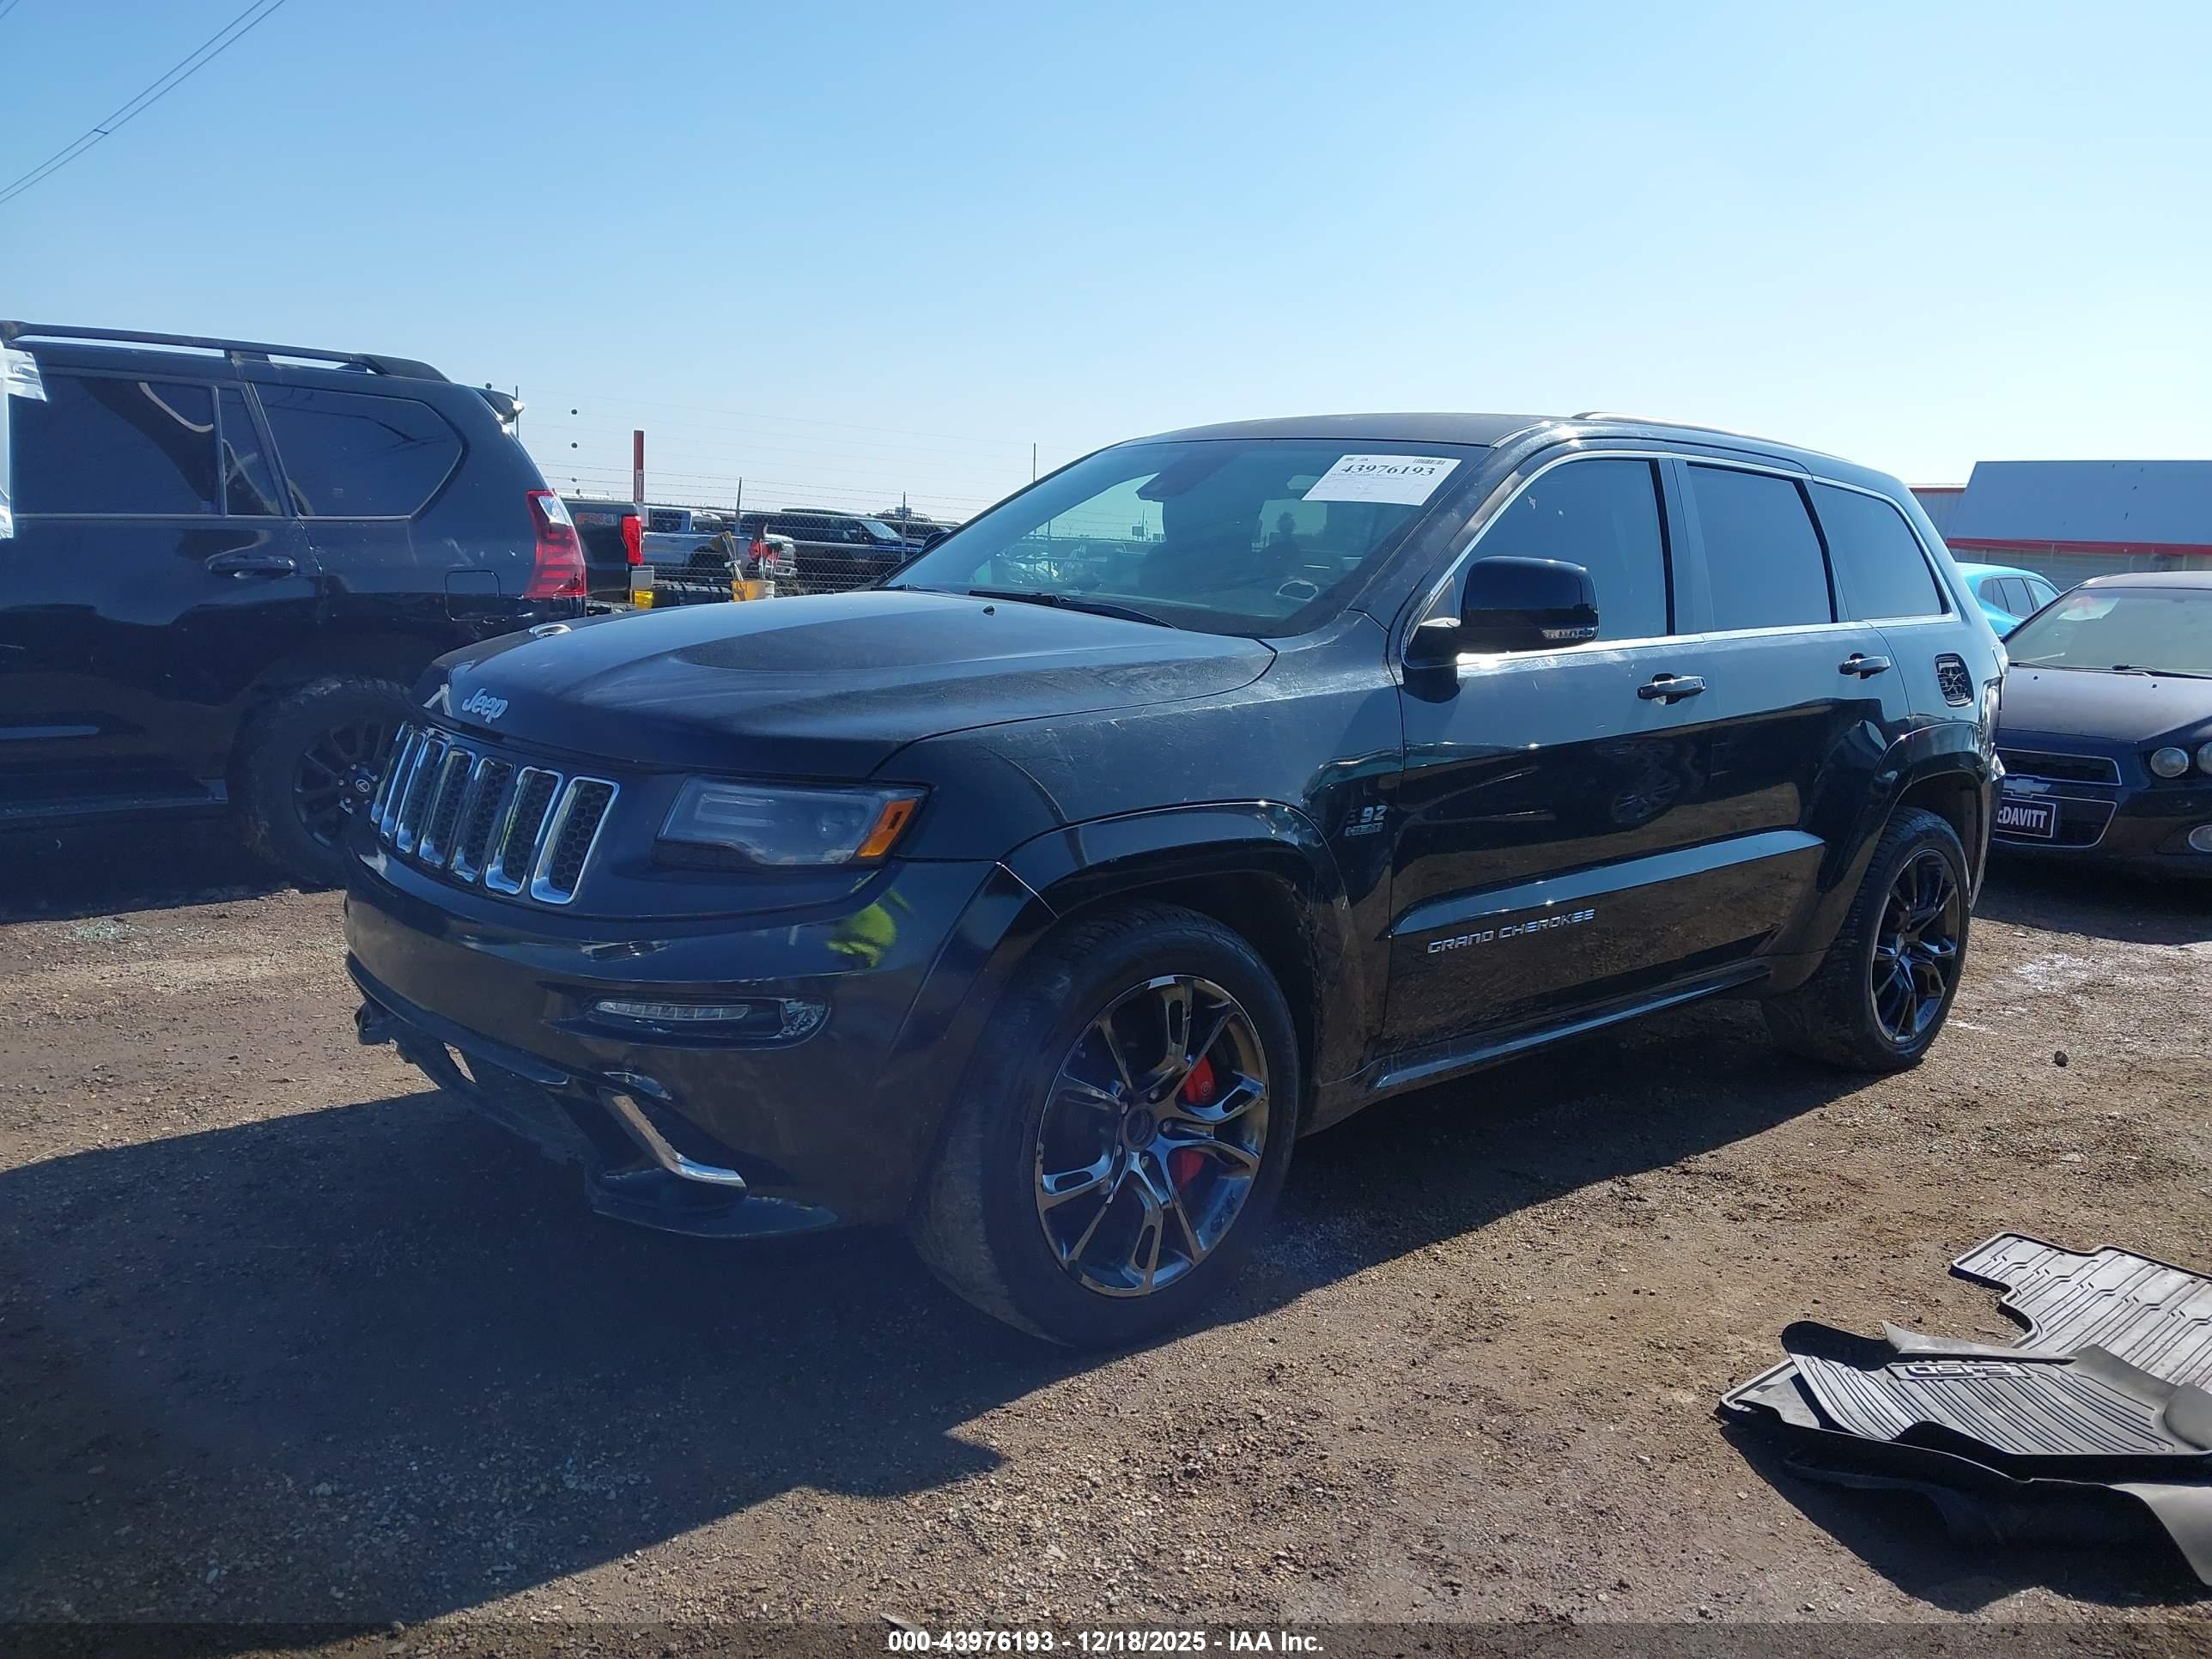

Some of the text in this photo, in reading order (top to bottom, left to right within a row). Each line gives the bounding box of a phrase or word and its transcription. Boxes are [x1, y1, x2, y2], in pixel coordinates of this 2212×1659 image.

[1340, 464, 1436, 477] 43976193
[461, 688, 508, 724] Jeep
[1996, 806, 2047, 829] cDAVITT
[1427, 908, 1595, 954] GRAND CHEROKEE
